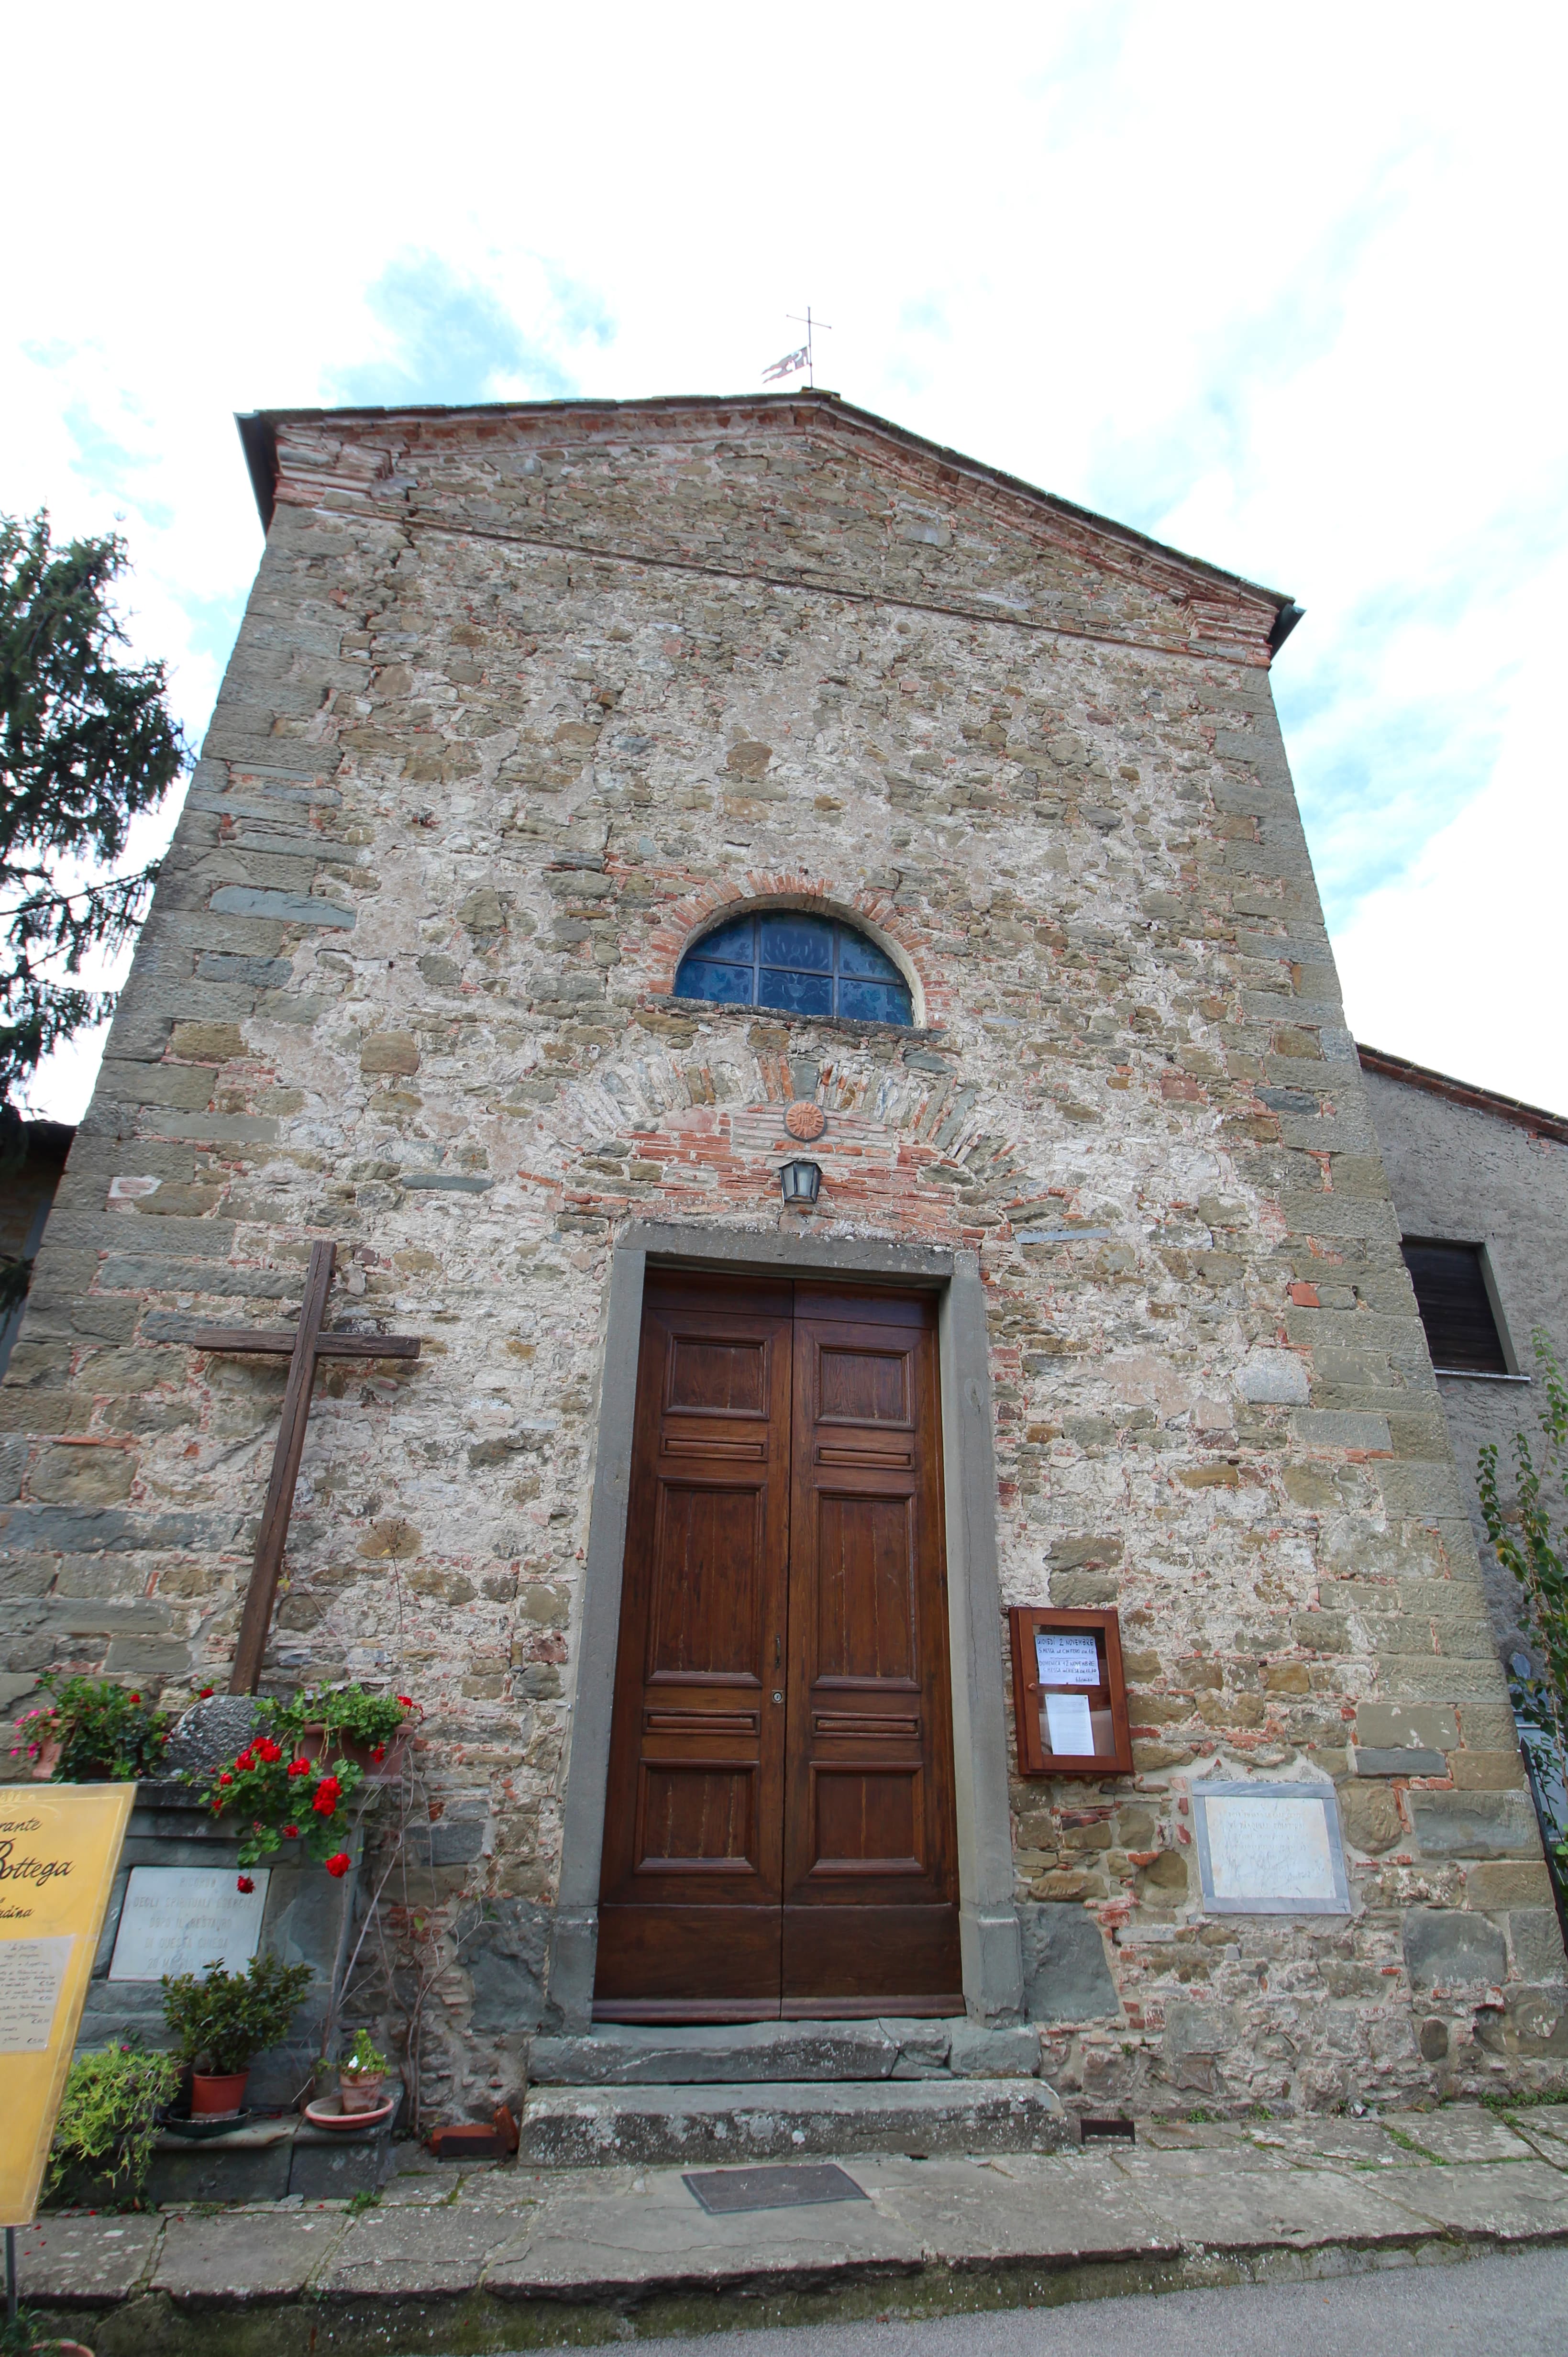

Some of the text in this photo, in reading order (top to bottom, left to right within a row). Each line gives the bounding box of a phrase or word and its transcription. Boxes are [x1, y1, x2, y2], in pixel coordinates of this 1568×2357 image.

[133, 1896, 159, 1908] DEGLI
[165, 1897, 211, 1909] SPIRITUALI
[149, 1917, 232, 1929] DOPO IL RESTAURO
[160, 1937, 192, 1949] QUESTA
[198, 1937, 229, 1949] CHIESA
